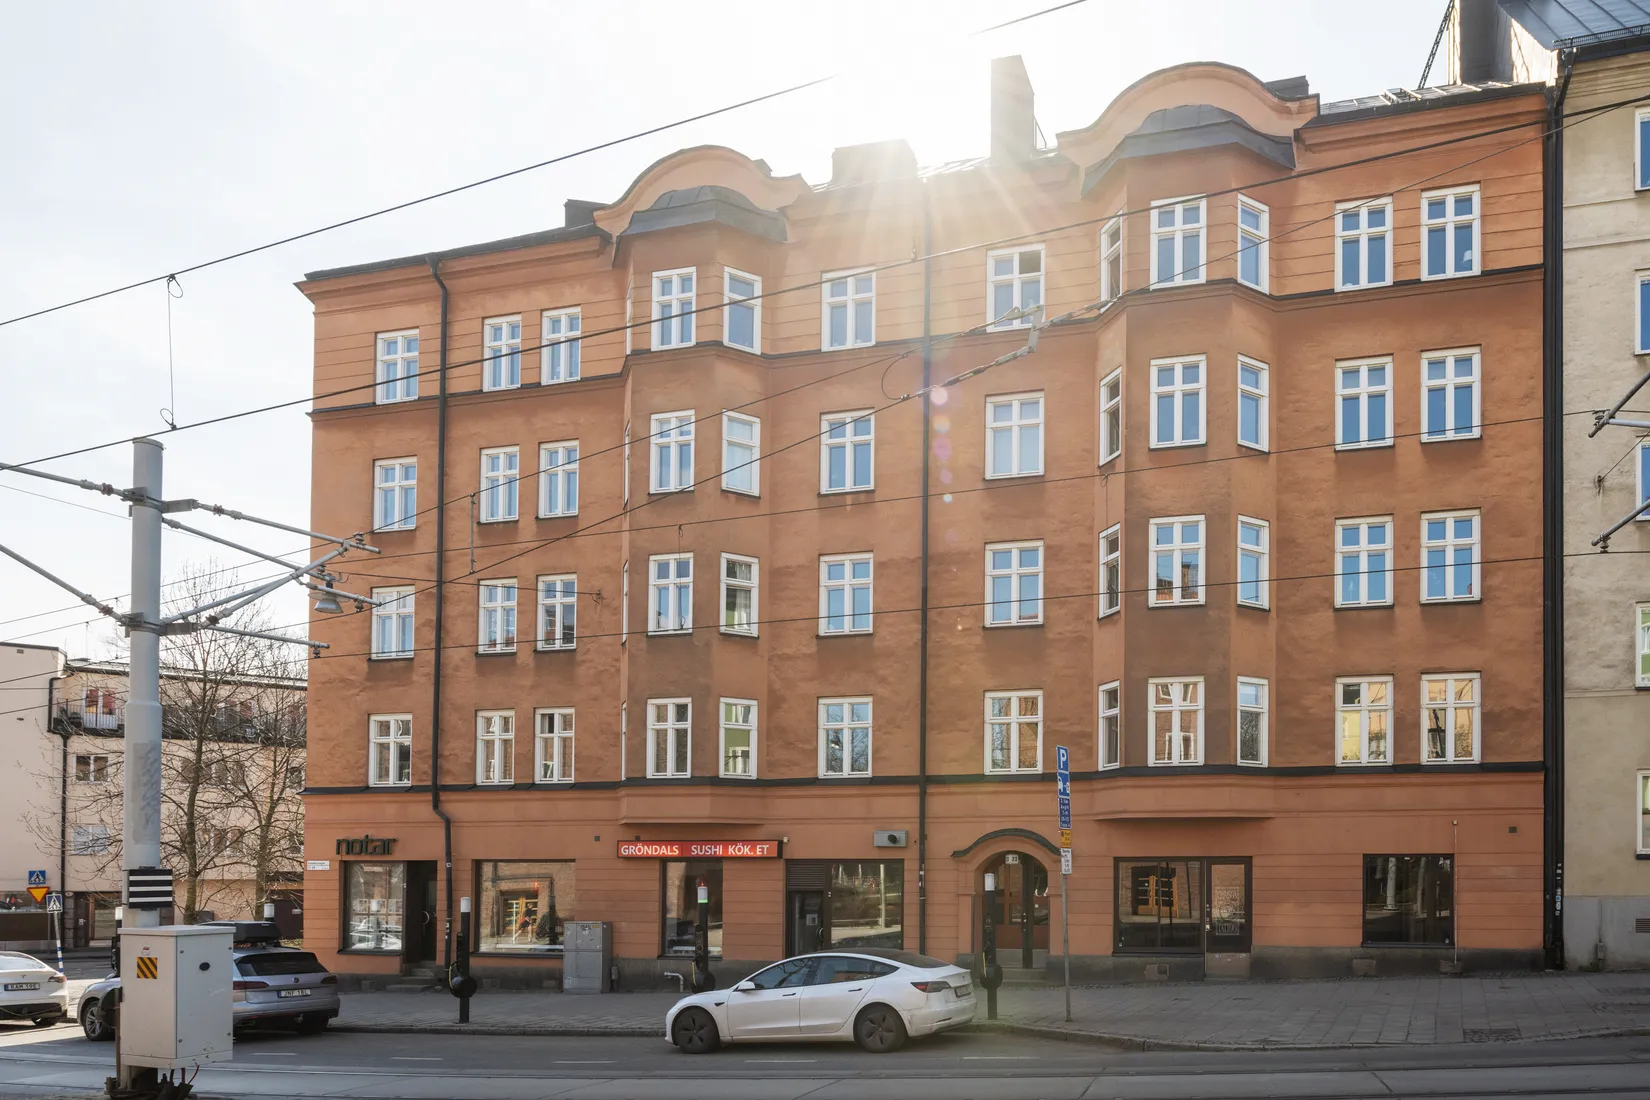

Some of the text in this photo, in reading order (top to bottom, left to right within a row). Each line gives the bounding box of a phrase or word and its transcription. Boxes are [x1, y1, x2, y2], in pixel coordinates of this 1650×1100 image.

[1059, 748, 1067, 769] P
[336, 834, 397, 855] notar
[621, 842, 769, 855] GRÖNDALS SUSHI KÖK. ET
